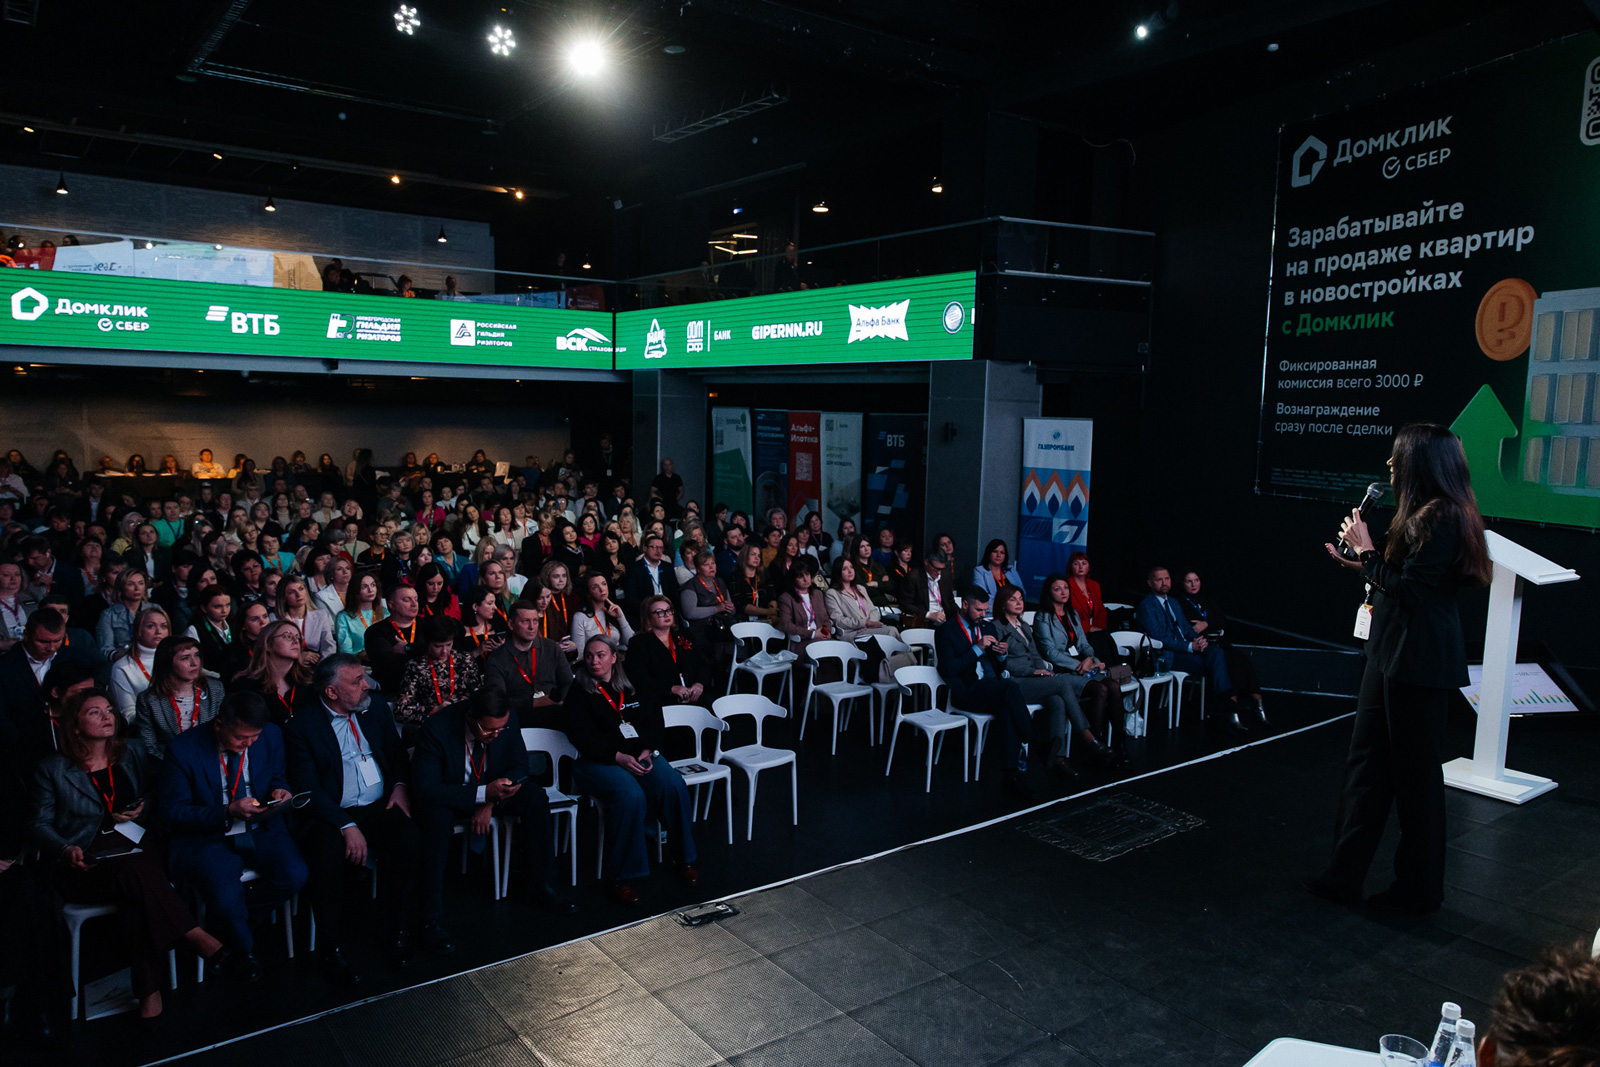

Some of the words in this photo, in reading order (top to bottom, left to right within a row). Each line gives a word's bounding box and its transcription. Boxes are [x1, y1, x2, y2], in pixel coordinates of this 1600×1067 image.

[1404, 147, 1452, 171] СБЕР
[1288, 200, 1464, 249] Зарабатывайте
[1286, 259, 1309, 277] на
[1314, 243, 1413, 272] продаже
[1419, 225, 1536, 259] квартир
[1283, 289, 1295, 306] в
[1300, 269, 1464, 304] новостройках
[115, 321, 150, 331] СБЕР
[231, 311, 281, 336] ВТБ
[355, 321, 401, 331] ГИЛЬДИЯ
[476, 321, 517, 329] РОССИЙСКАЯ
[855, 317, 880, 328] Альфа
[881, 315, 901, 326] Банк
[1281, 319, 1292, 335] с
[1296, 310, 1395, 337] Домклик
[356, 332, 402, 342] РИЭЛТОРОВ
[713, 329, 732, 341] БАНК
[751, 321, 823, 340] GIPERNN.RU
[476, 339, 513, 347] РИЭЛТОРОВ
[556, 336, 588, 351] ВСК
[1279, 357, 1378, 373] Фиксированная
[1278, 377, 1333, 389] комиссия
[1336, 377, 1372, 389] всего
[1374, 373, 1410, 388] 3000
[1276, 402, 1380, 418] Вознаграждение
[791, 423, 815, 434] Альфа-
[1274, 421, 1305, 434] сразу
[1308, 422, 1344, 434] после
[1346, 423, 1394, 437] сделки
[790, 434, 819, 443] Ипотека
[886, 434, 905, 448] ВТБ
[1038, 443, 1075, 451] ГАЗПРОМБАНК
